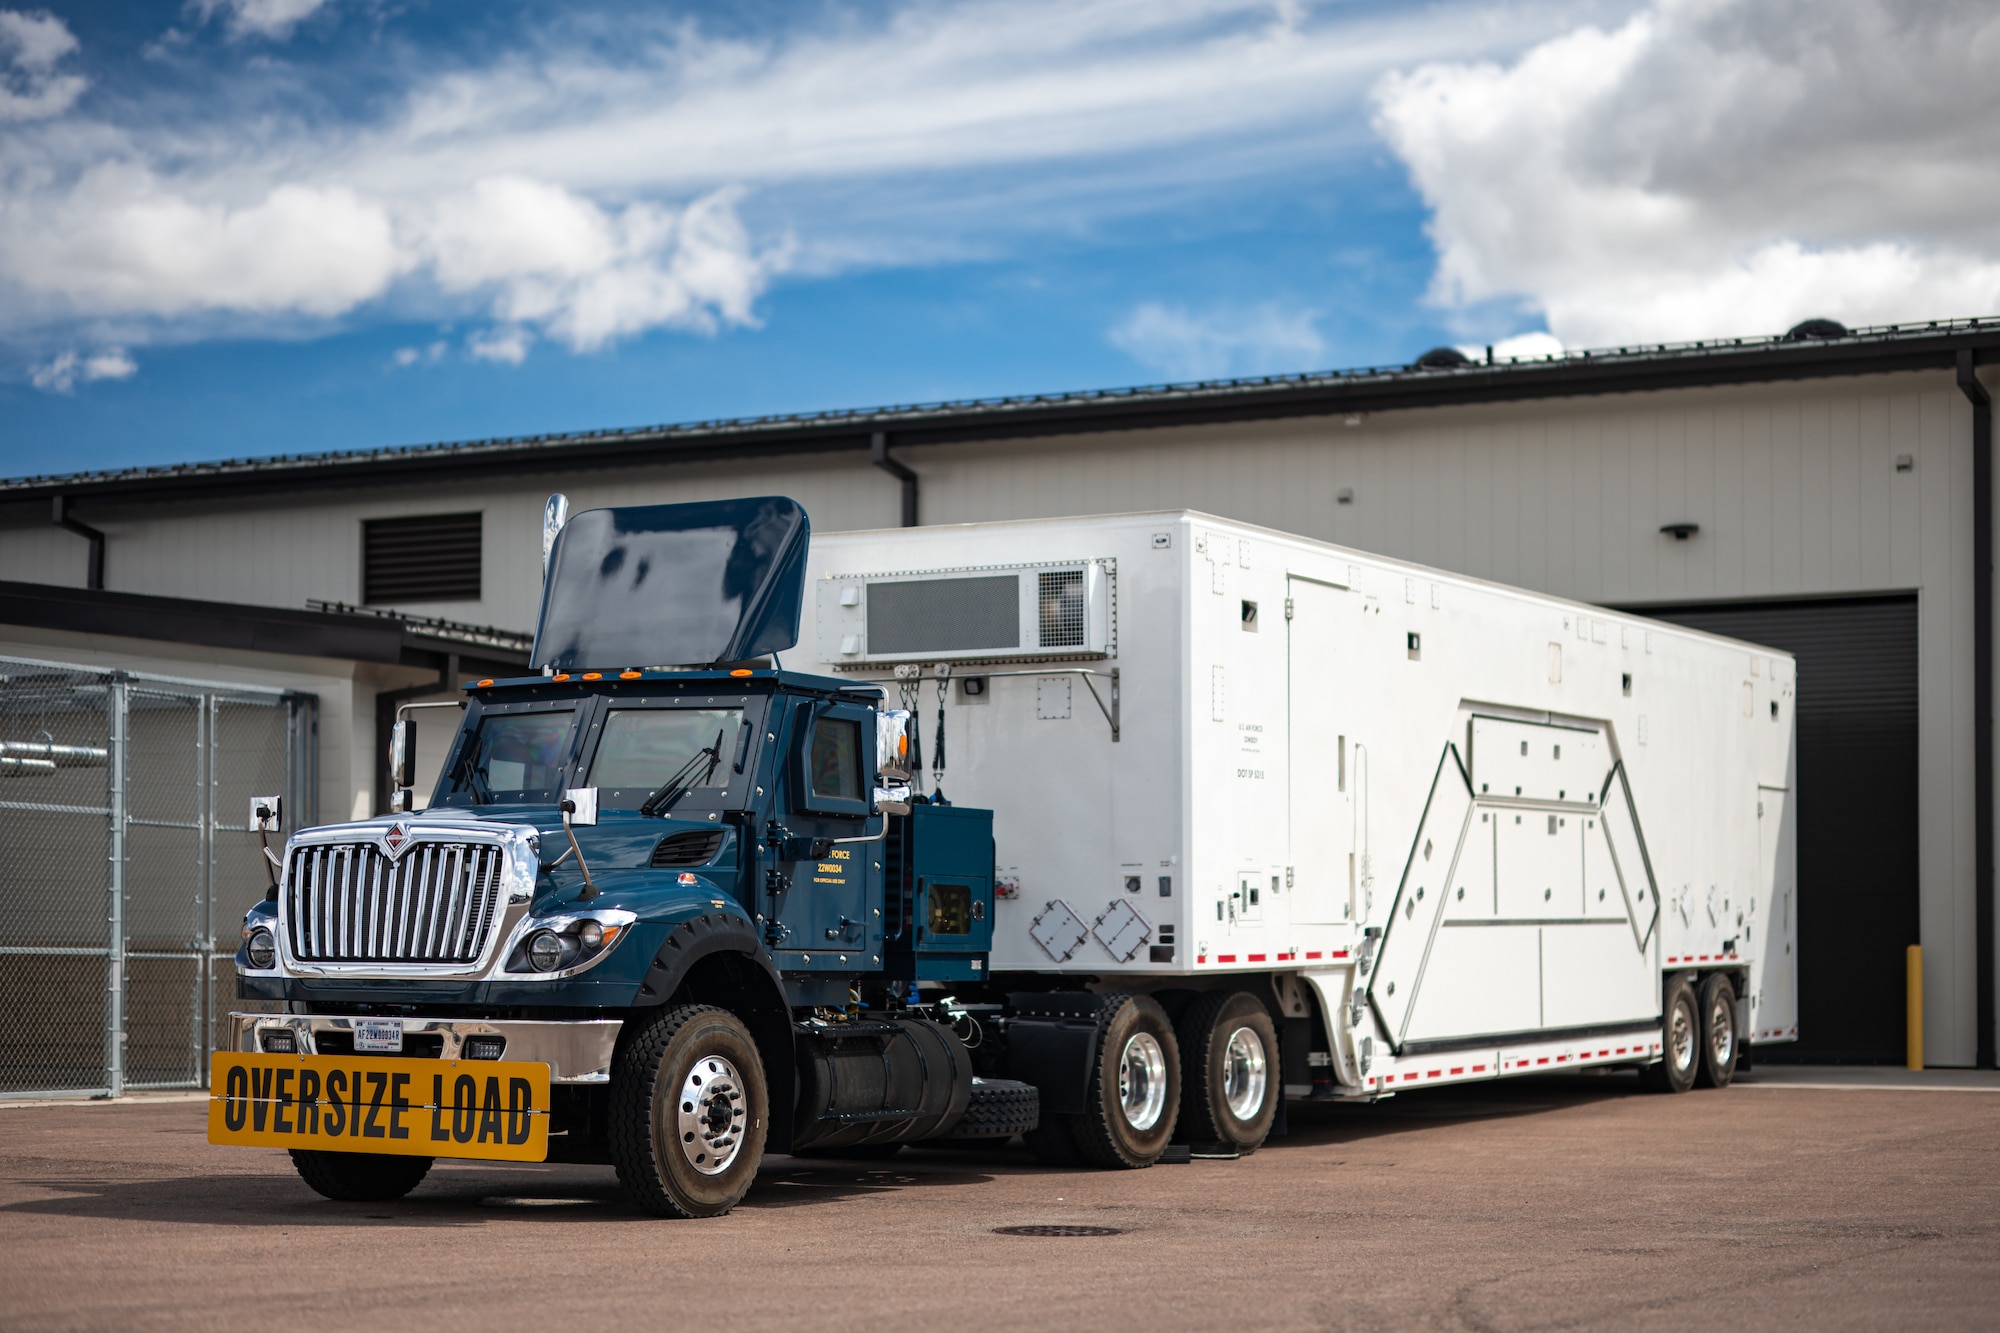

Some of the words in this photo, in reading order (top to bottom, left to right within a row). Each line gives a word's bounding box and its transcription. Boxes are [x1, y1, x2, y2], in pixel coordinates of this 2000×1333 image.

[1237, 769, 1247, 778] DOT
[831, 849, 850, 860] FORCE
[225, 1065, 410, 1139] OVERSIZE
[430, 1074, 532, 1145] LOAD
